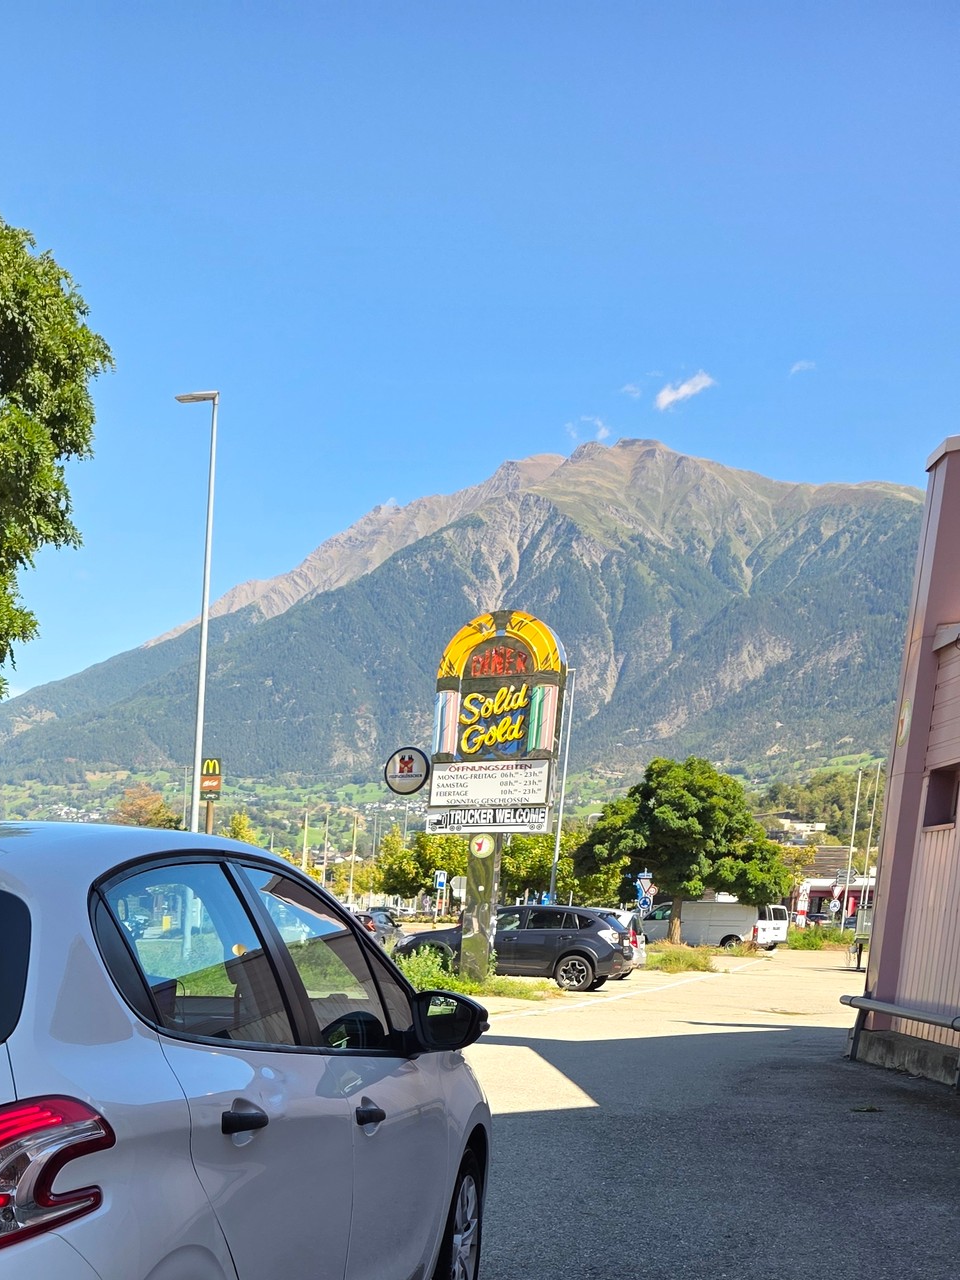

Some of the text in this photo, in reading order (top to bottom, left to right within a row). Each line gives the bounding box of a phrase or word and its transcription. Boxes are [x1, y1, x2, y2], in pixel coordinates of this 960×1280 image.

[471, 646, 527, 677] DINER
[459, 683, 529, 725] Solid
[461, 715, 524, 754] Gold
[448, 763, 533, 772] ÖFFNUNGSZEITEN
[450, 808, 546, 824] TRUCKER WELCOME
